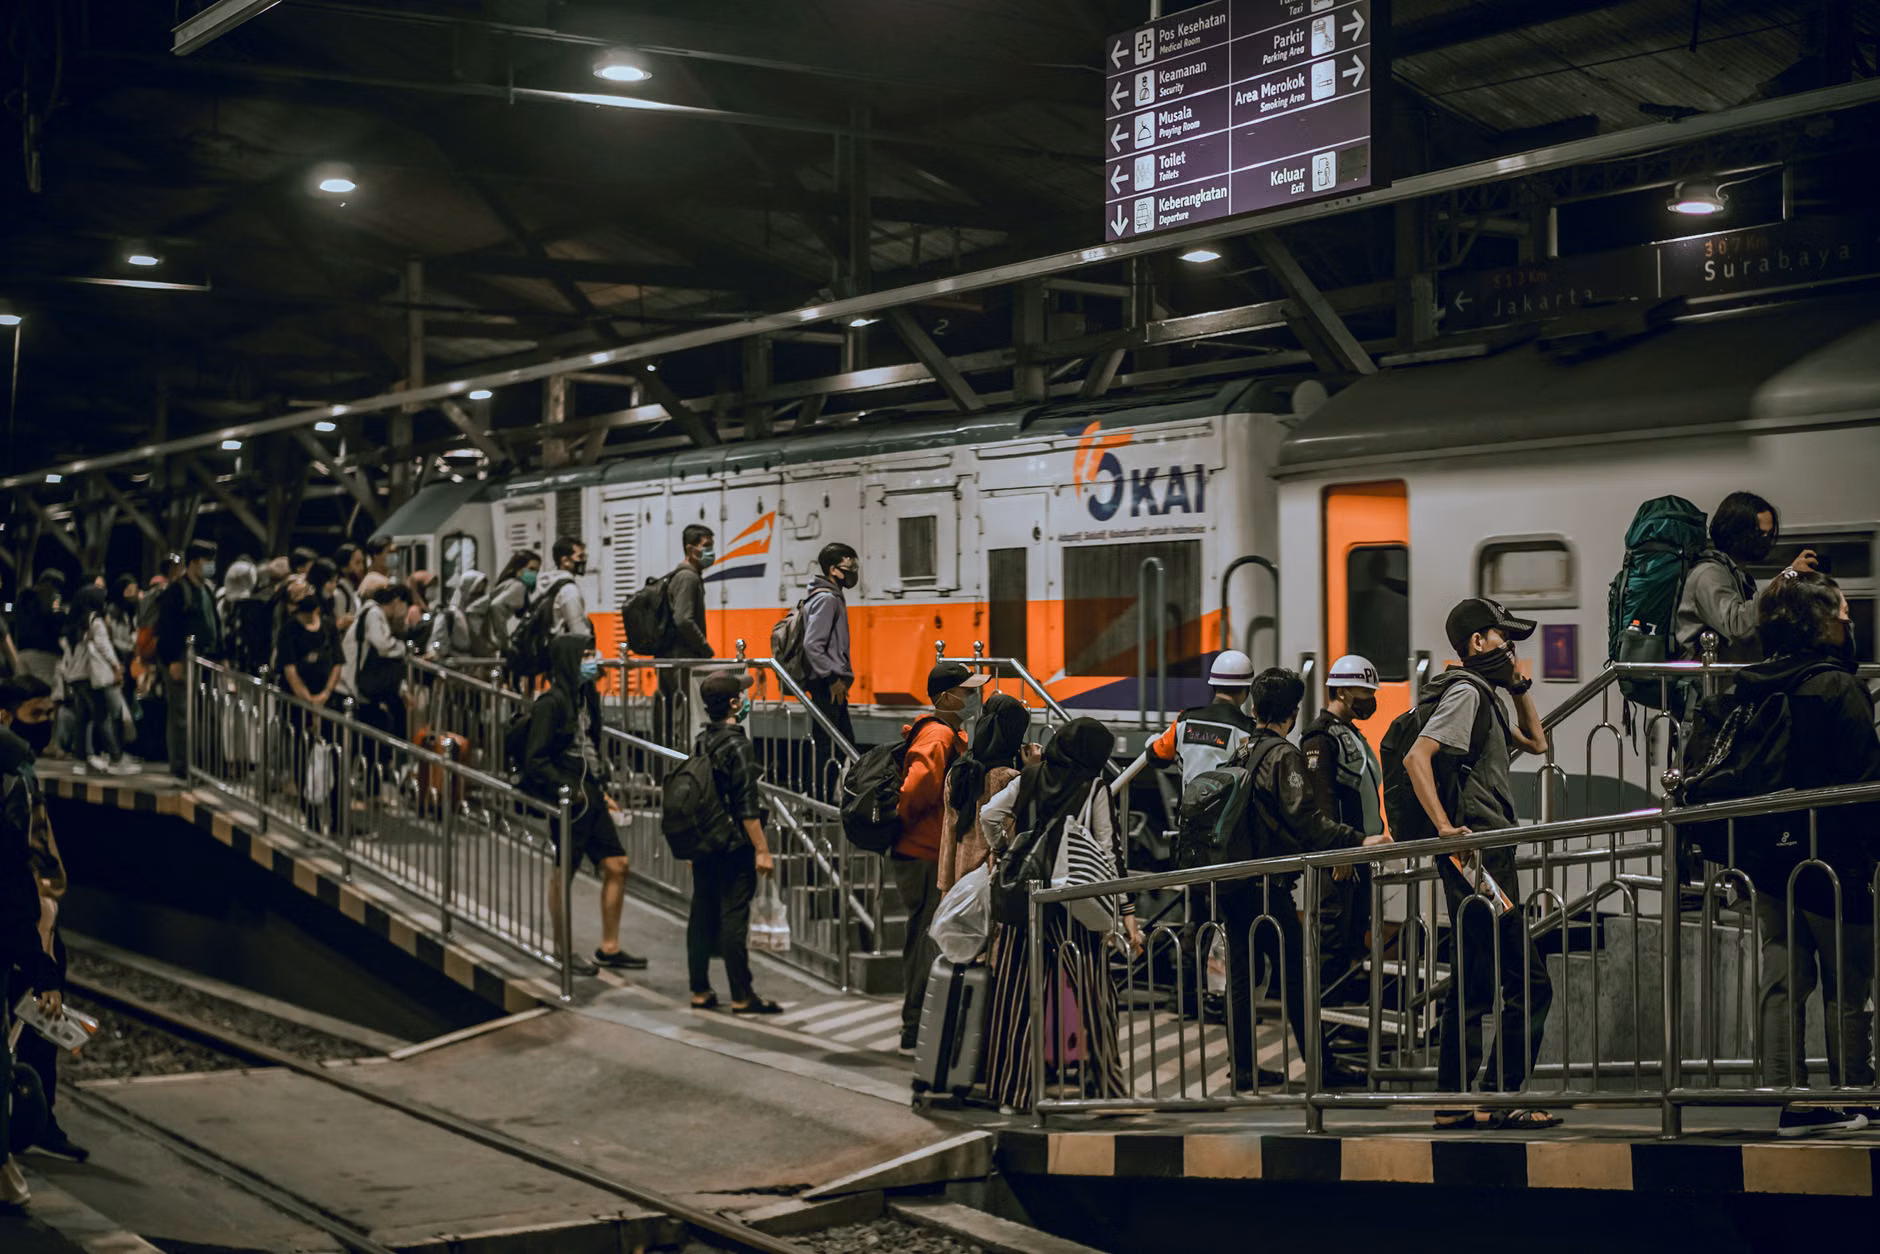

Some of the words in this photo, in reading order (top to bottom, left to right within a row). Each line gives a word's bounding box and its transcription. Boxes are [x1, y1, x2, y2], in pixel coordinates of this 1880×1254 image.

[1159, 29, 1175, 42] Pos
[1177, 14, 1226, 37] Kesehatan
[1159, 41, 1183, 55] Medical
[1183, 37, 1201, 48] Room
[1273, 28, 1305, 49] Parkir
[1262, 51, 1288, 65] Parking
[1288, 46, 1305, 57] Area
[1159, 62, 1207, 84] Keamanan
[1159, 83, 1185, 97] Security
[1234, 90, 1259, 106] Area
[1260, 73, 1305, 98] Merokok
[1260, 97, 1288, 112] Smoking
[1288, 93, 1306, 104] Area
[1158, 106, 1192, 125] Musala
[1158, 125, 1183, 139] Praying
[1182, 120, 1201, 132] Room
[1158, 151, 1186, 169] Toilet
[1158, 169, 1180, 182] Toilets
[1270, 167, 1305, 186] Keluar
[1290, 182, 1305, 195] Exit
[1158, 186, 1228, 212] Keberangkatan
[1158, 210, 1190, 226] Departure
[1703, 243, 1851, 281] Surabaya
[1493, 287, 1594, 318] Jakarta
[932, 319, 950, 335] 2
[1130, 464, 1206, 518] KAI
